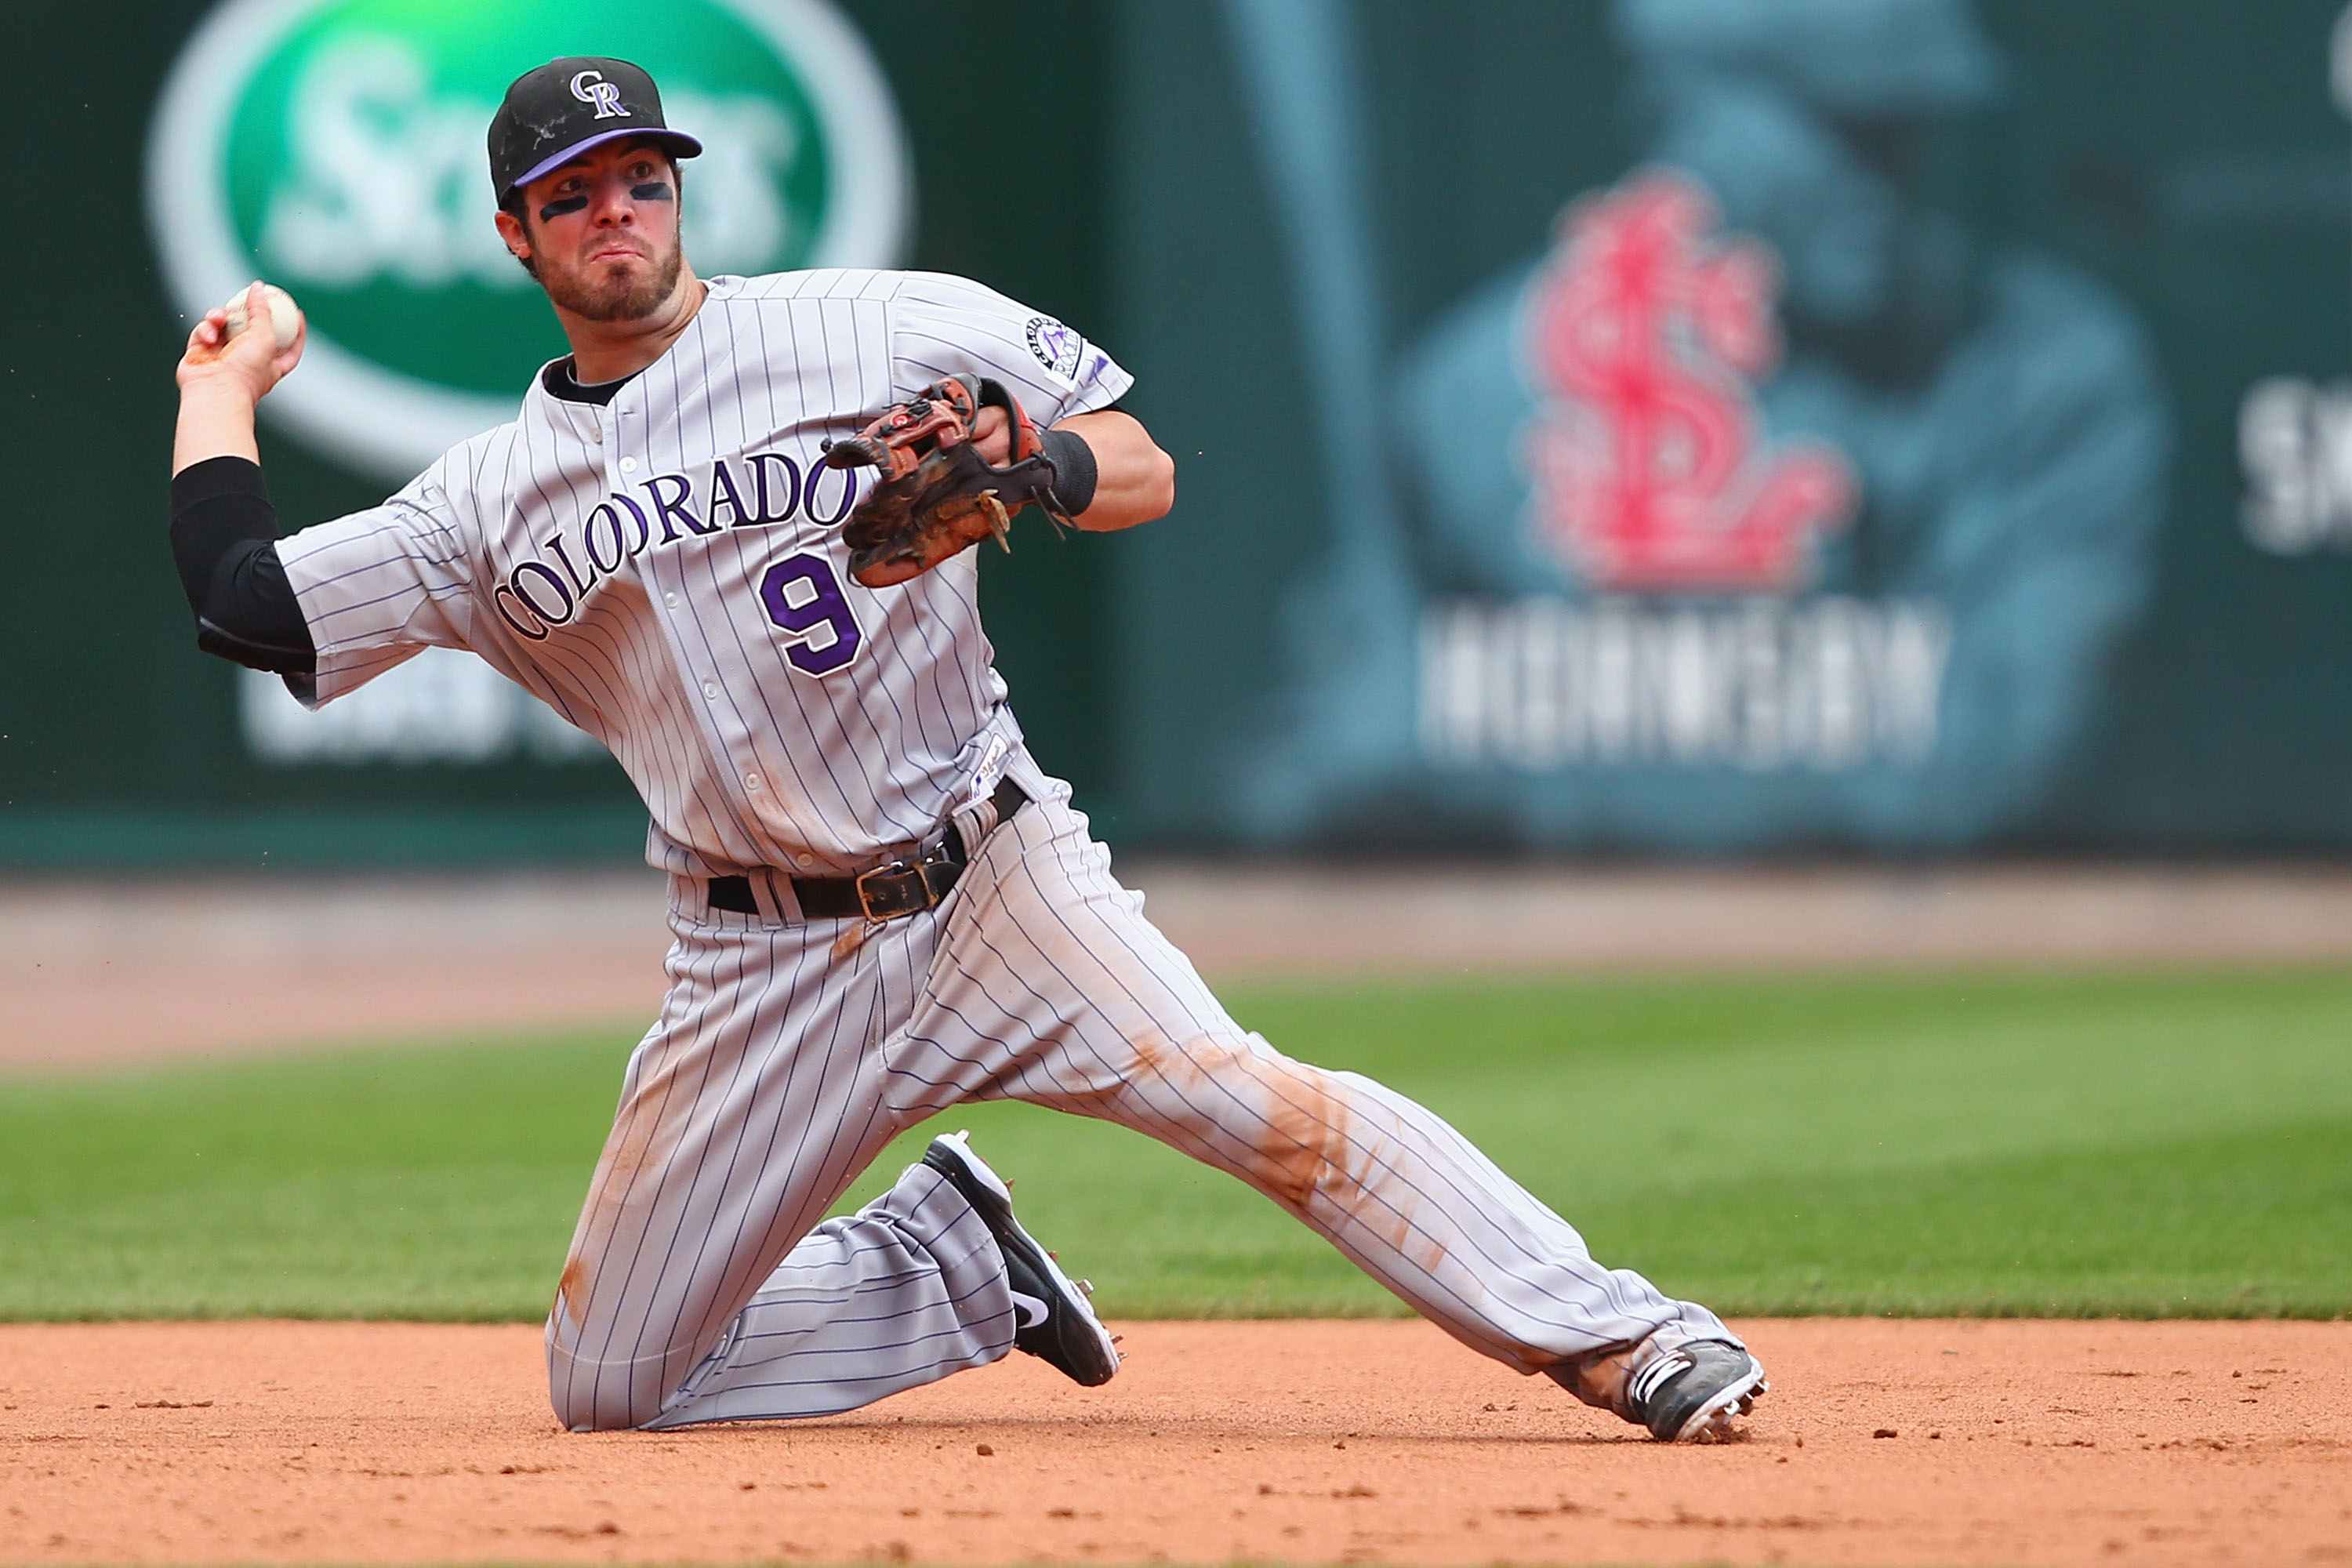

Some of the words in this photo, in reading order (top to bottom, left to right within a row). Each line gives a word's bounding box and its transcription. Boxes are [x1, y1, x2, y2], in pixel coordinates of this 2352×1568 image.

[570, 71, 632, 120] CR
[493, 451, 859, 642] COLORADO
[757, 551, 866, 679] 9
